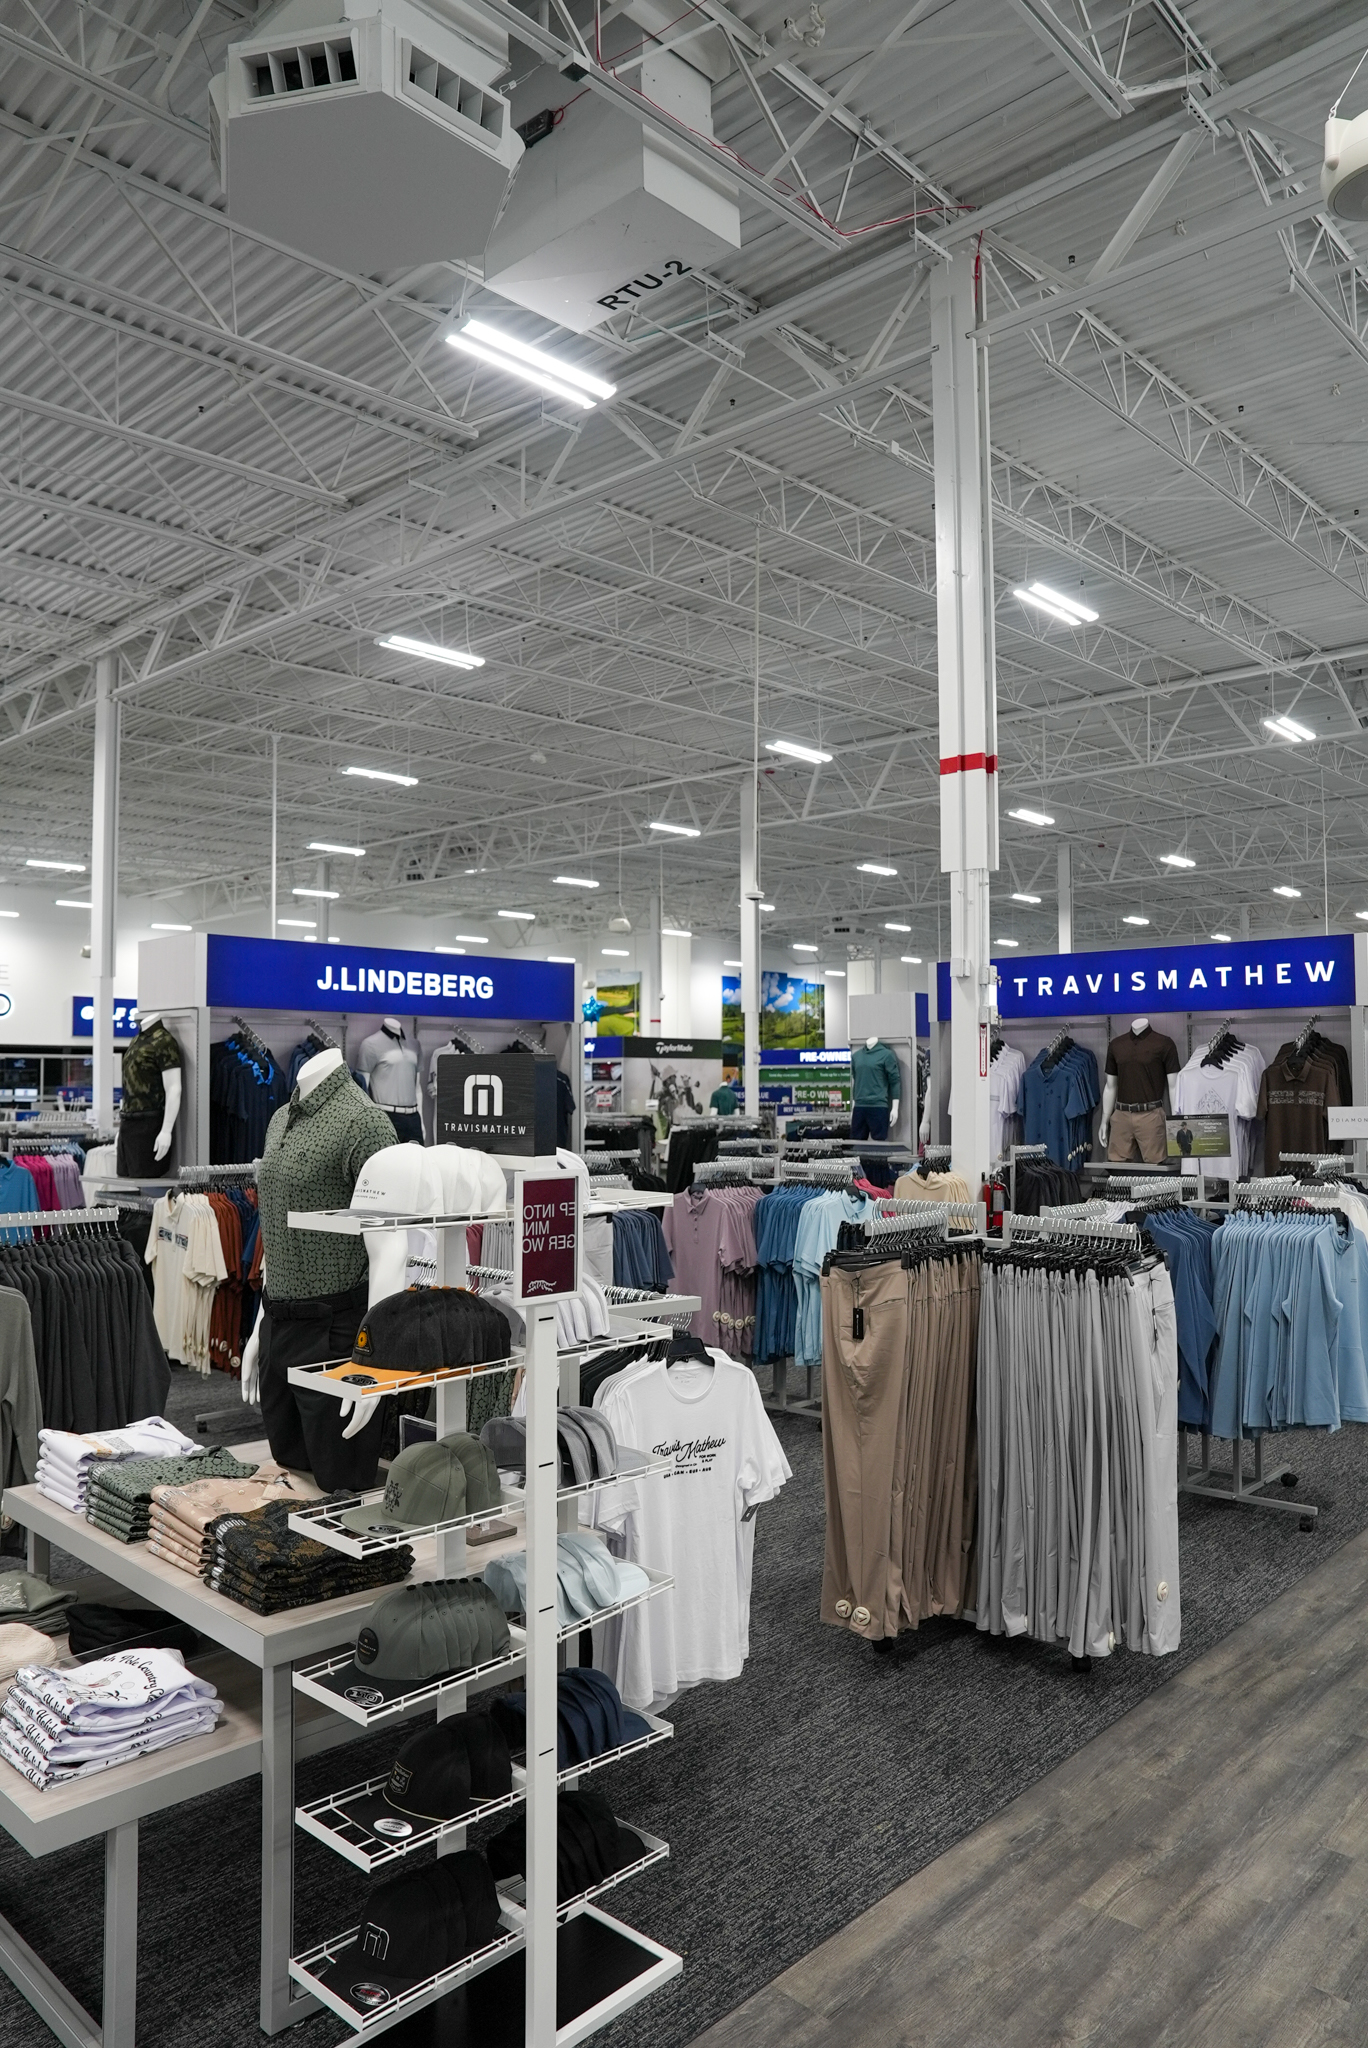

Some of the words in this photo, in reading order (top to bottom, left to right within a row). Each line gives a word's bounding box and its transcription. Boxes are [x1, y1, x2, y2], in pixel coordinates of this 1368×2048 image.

[596, 260, 693, 311] RTU-2
[316, 965, 494, 999] J.LINDEBERG
[1013, 960, 1335, 997] TRAVISMATHEW
[655, 1041, 693, 1055] TaylorMade
[444, 1122, 526, 1135] TRAVISMATHEW
[652, 1440, 681, 1457] Travis
[675, 1435, 727, 1463] Mathew
